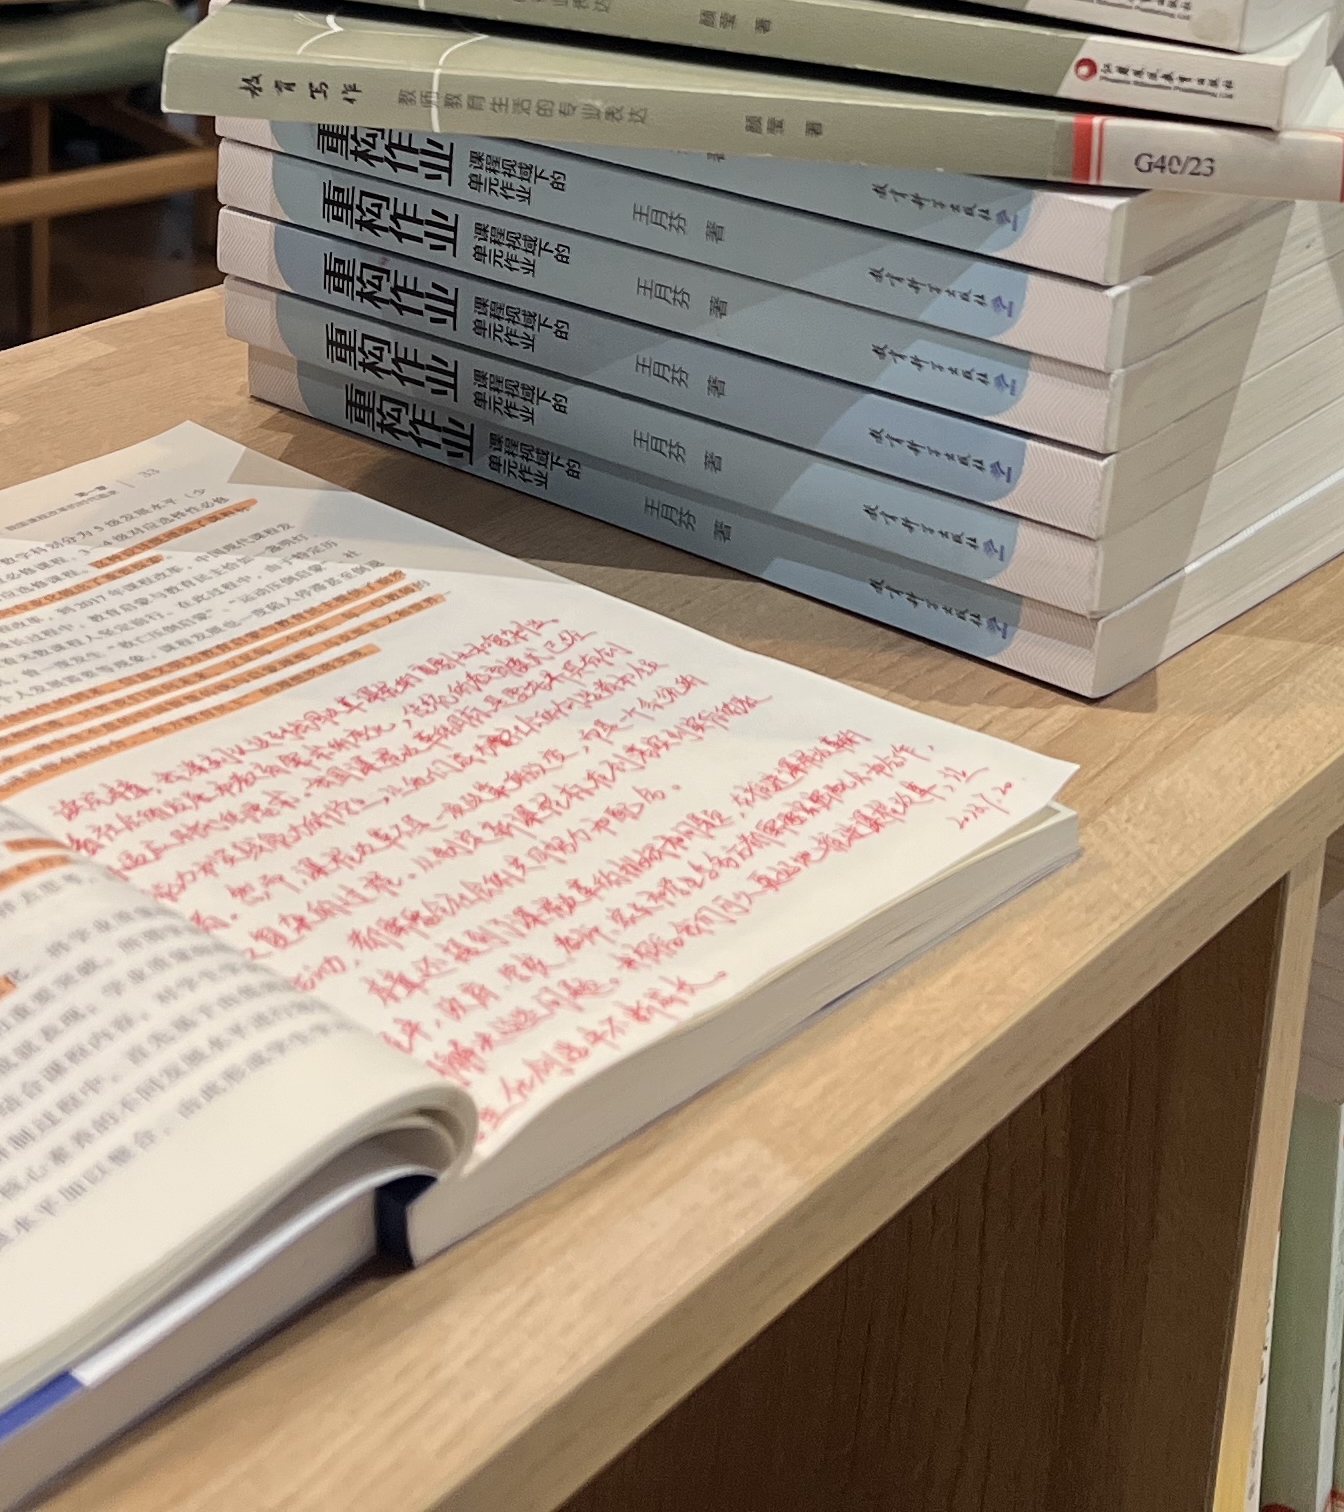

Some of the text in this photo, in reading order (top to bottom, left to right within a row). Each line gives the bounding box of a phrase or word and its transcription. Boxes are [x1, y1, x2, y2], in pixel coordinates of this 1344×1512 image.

[1134, 153, 1216, 179] G40/23
[323, 179, 459, 257] 重构作业
[633, 203, 726, 243] 王月芬 著
[324, 251, 458, 331] 重构作业
[638, 277, 728, 319] 王月芬 著
[869, 267, 989, 307] 教育科学出版社
[326, 322, 458, 402] 重构作业
[635, 355, 727, 398] 王月芬 著
[872, 343, 990, 386] 教育科学出版社
[345, 383, 474, 465] 重构作业
[634, 430, 724, 474] 王月芬 著
[869, 428, 985, 472] 教育科学出版社
[135, 467, 163, 478] 33
[645, 497, 733, 544] 王月芬 著
[863, 504, 980, 551] 教育科学出版社
[869, 578, 983, 627] 教育科学出版社
